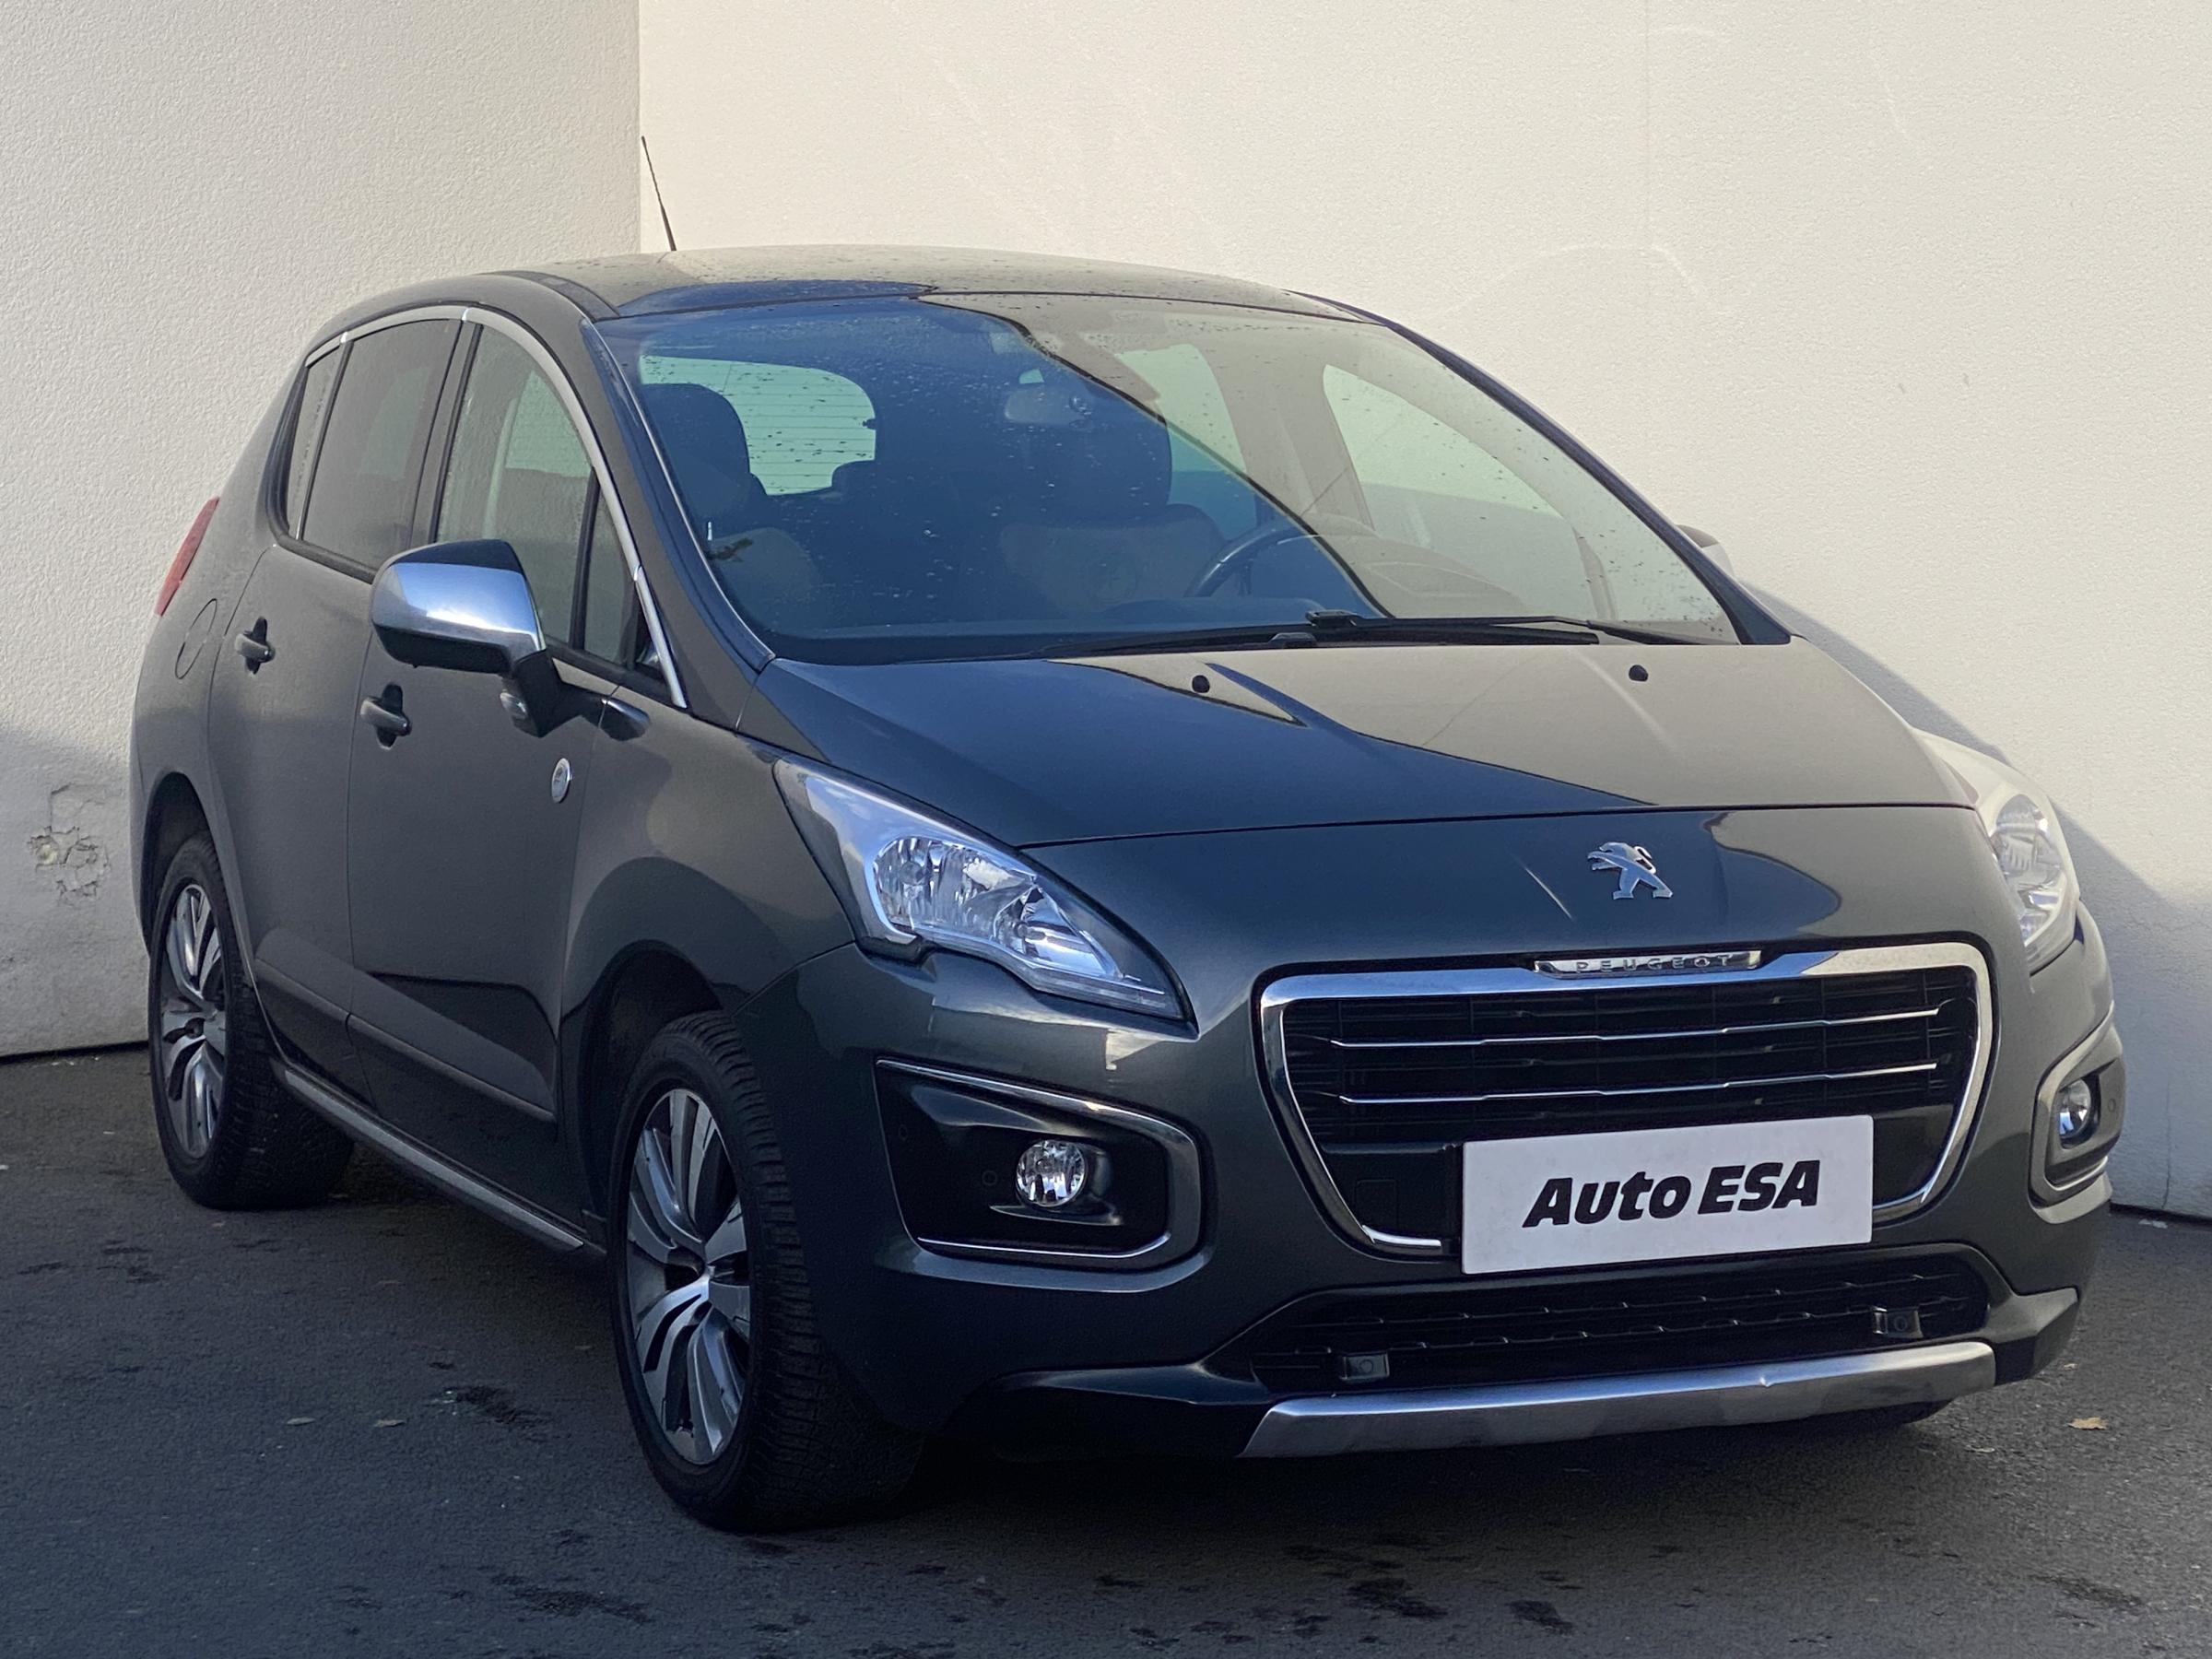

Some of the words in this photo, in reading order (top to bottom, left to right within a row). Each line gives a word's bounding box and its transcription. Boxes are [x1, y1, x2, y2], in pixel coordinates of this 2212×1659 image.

[1575, 954, 1735, 973] PEUGEOT
[1522, 1171, 1692, 1229] Auto
[1697, 1159, 1820, 1216] ESA
